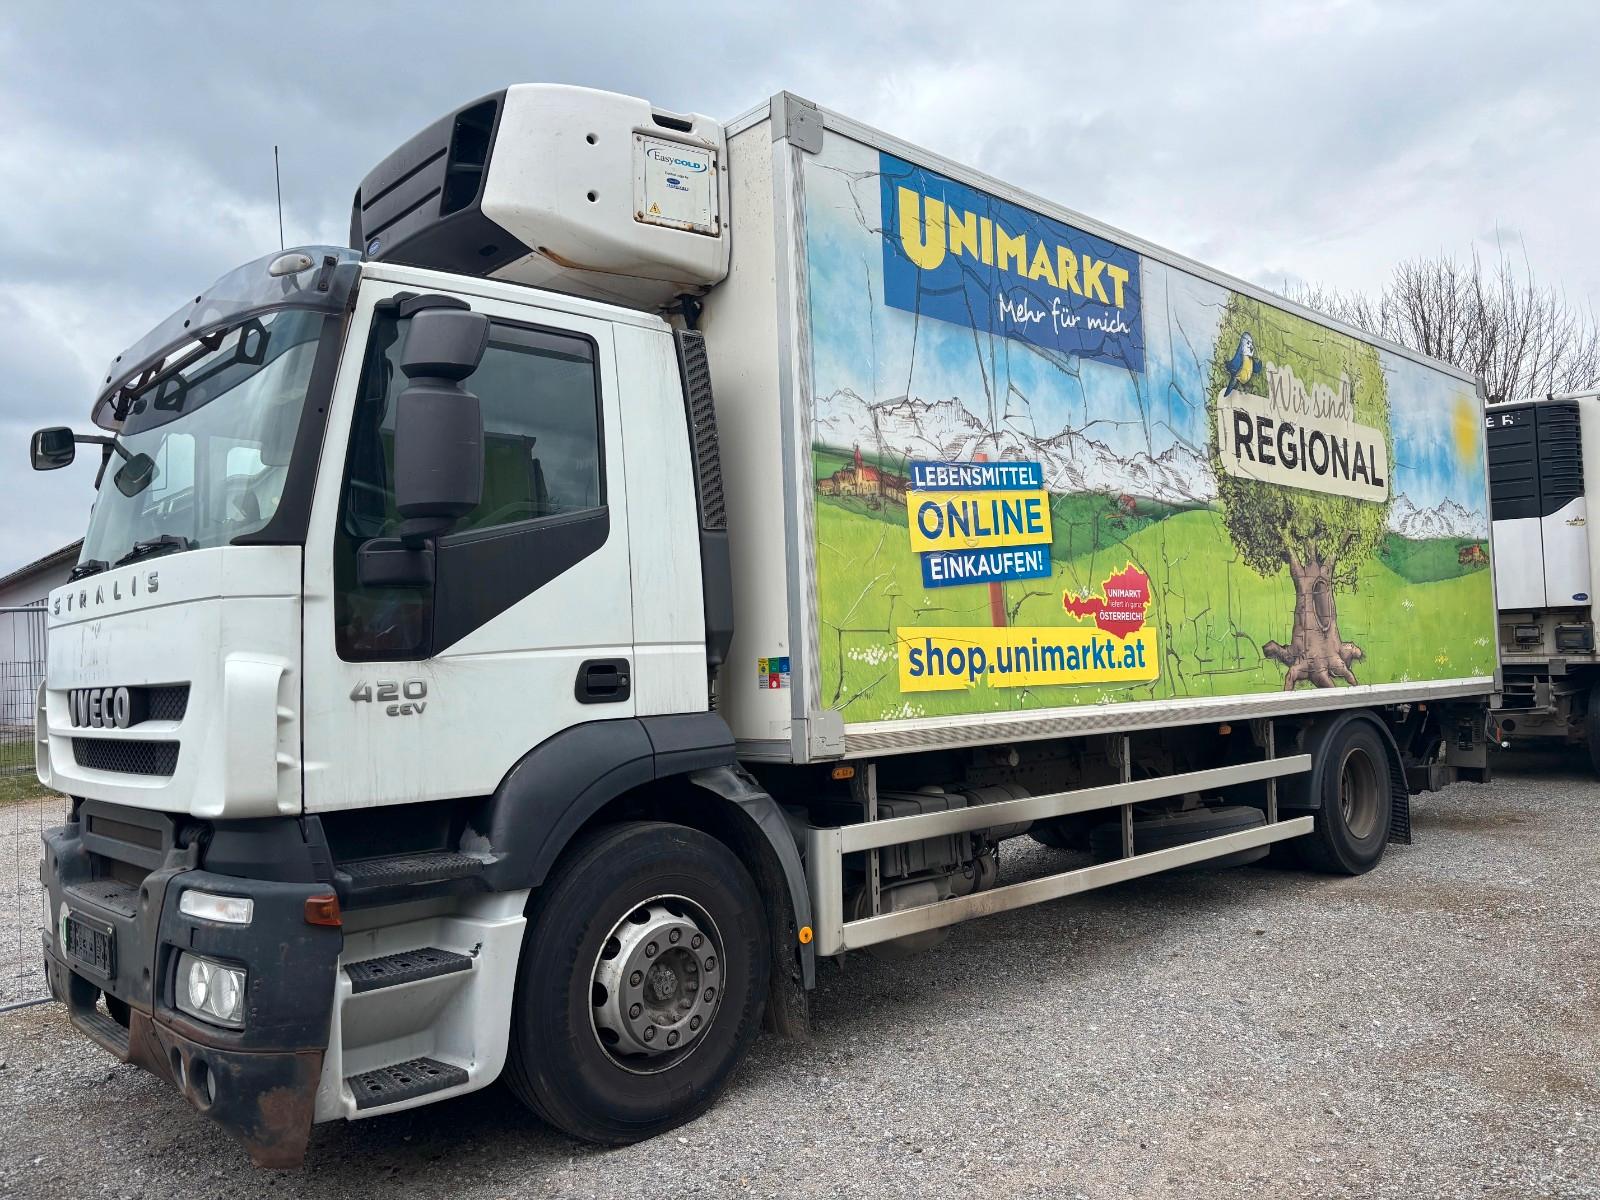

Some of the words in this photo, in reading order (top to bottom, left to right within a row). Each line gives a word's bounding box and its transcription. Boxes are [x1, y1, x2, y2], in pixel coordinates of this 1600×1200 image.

[898, 185, 1129, 309] UNIMARKT
[999, 292, 1046, 325] Mehr
[1050, 296, 1081, 335] für
[1268, 370, 1309, 415] Wir
[1313, 381, 1350, 421] sind
[1233, 409, 1385, 488] REGIONAL
[915, 466, 1038, 487] LEBENSMITTEL
[917, 498, 1044, 540] ONLINE
[930, 550, 1044, 580] EINKAUFEN!
[53, 570, 159, 615] STRALIS
[1107, 589, 1142, 598] UNIMARKT
[1099, 609, 1143, 621] ÖSTERREICH!
[908, 636, 1147, 682] shop.unimarkt.at
[69, 686, 131, 729] IVECO
[349, 677, 428, 703] 420
[386, 701, 428, 717] EEV
